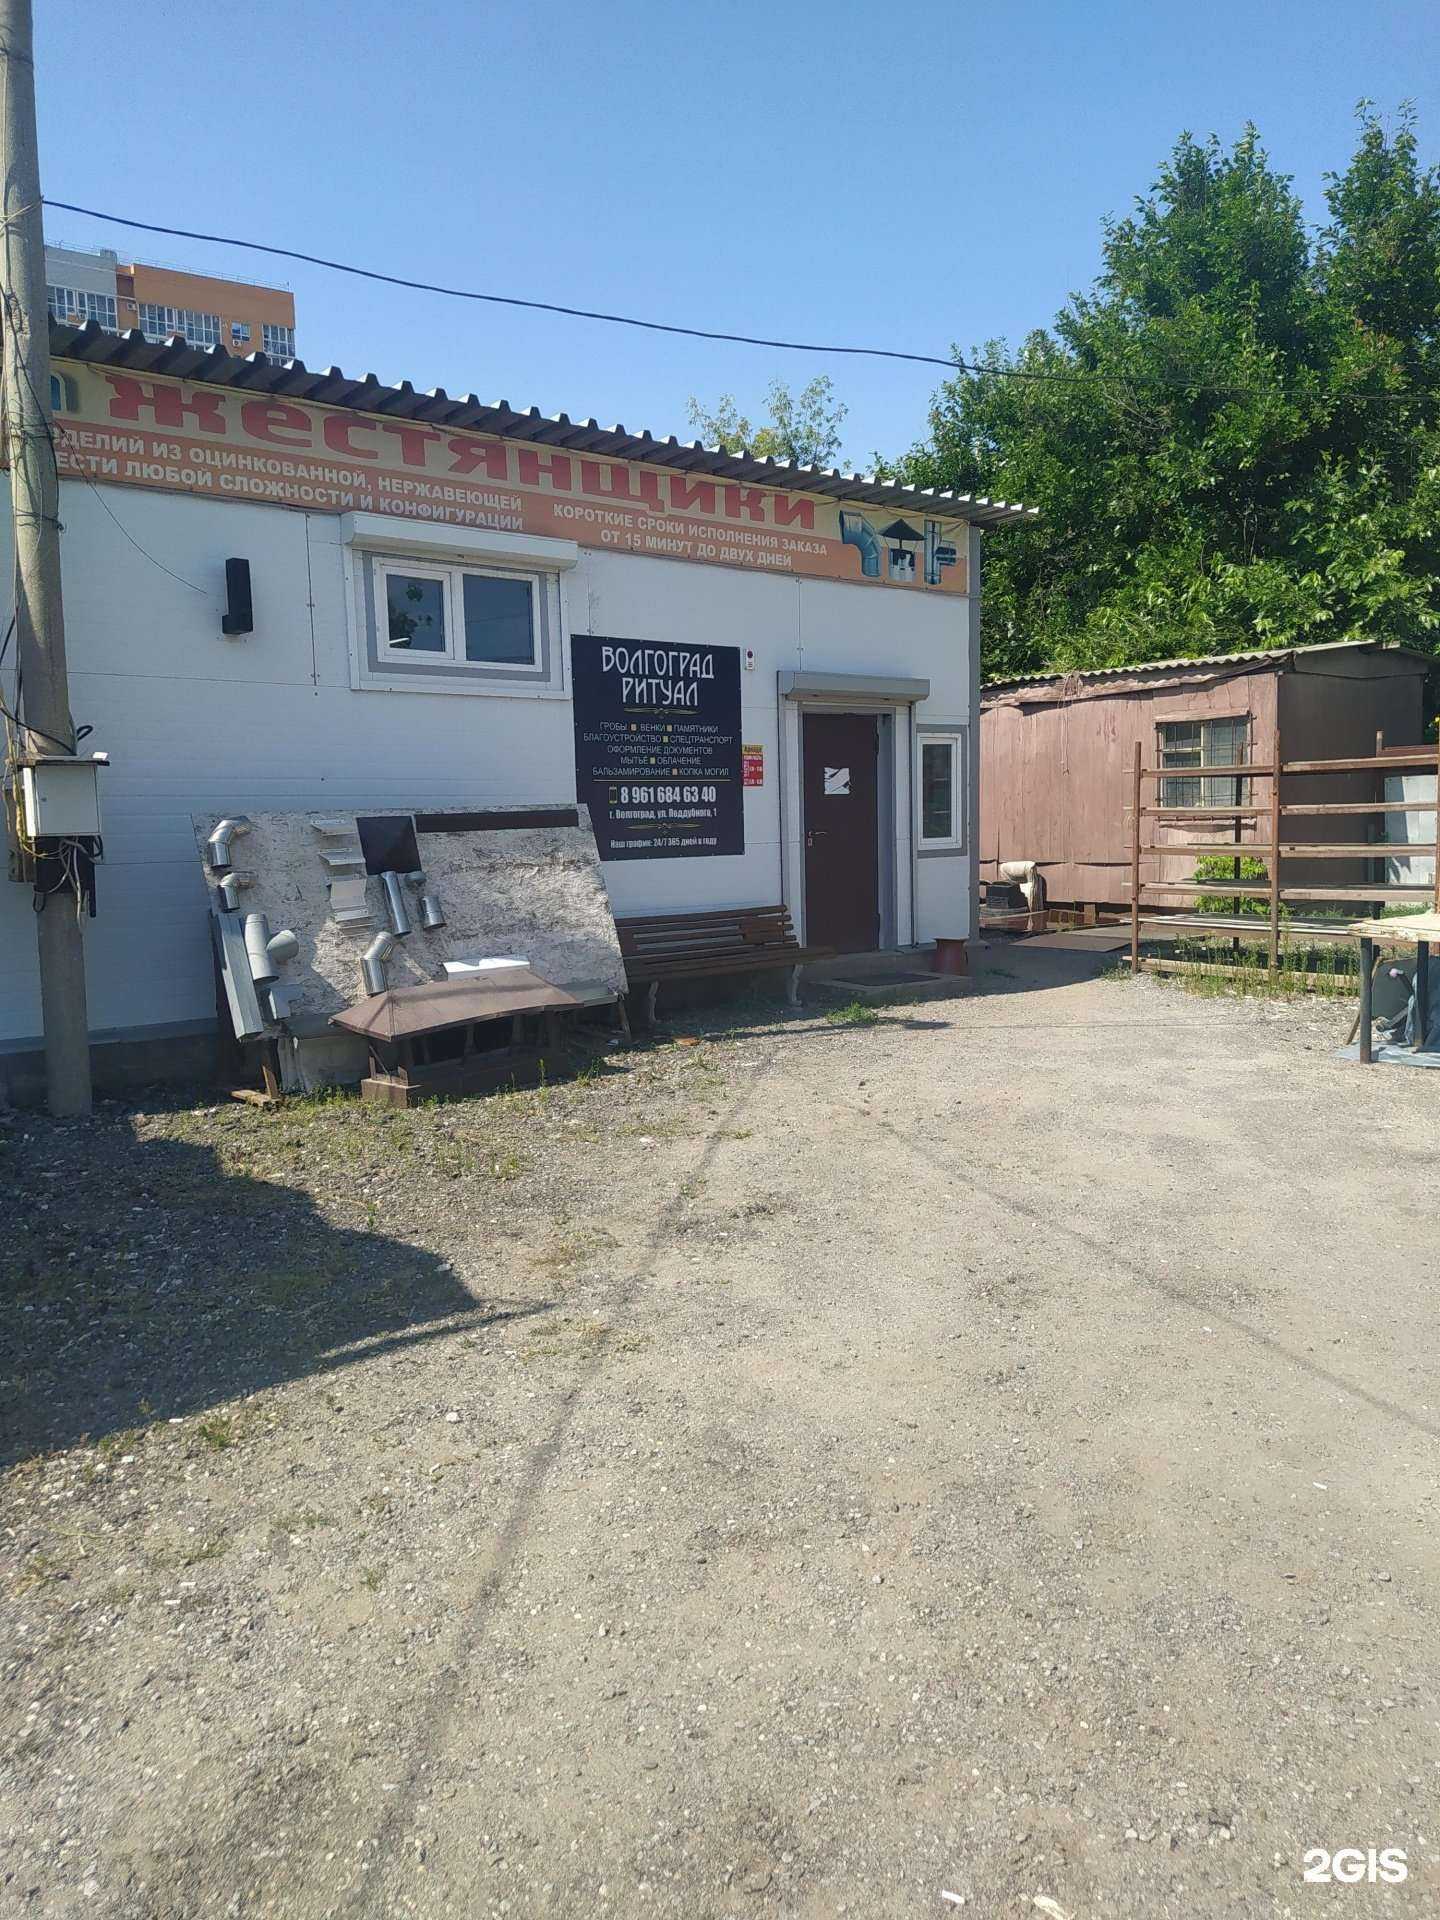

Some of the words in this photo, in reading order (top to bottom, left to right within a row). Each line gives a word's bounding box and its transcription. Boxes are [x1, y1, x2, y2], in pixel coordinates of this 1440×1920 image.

[53, 427, 145, 455] ДЕЛИЙ
[152, 441, 182, 460] ИЗ
[190, 447, 371, 491] ОЦИНКОВАННОЙ,
[378, 477, 522, 512] НЕРЖАВЕЮЩЕЙ
[55, 452, 118, 474] ЕСТИ
[125, 461, 213, 487] ЛЮБОЙ
[220, 474, 353, 507] СЛОЖНОСТИ
[361, 497, 373, 510] И
[379, 498, 523, 531] КОНФИГУРАЦИИ
[553, 503, 633, 528] КОРОТКИЕ
[637, 516, 684, 534] СРОКИ
[689, 524, 778, 548] ИСПОЛНЕНИЯ
[782, 538, 828, 555] ЗАКАЗА
[601, 530, 620, 544] ОТ
[625, 533, 641, 547] 15
[645, 535, 693, 554] МИНУТ
[696, 543, 716, 558] ДО
[719, 545, 754, 564] ДВУХ
[757, 551, 792, 567] ДНЕЙ
[601, 646, 715, 679] ВОЛГОГРАД
[622, 677, 698, 706] РИТУАЛ
[600, 722, 627, 731] ГРОБЫ
[640, 723, 665, 732] ВЕНКИ
[674, 725, 718, 734] ПАМЯТНИКИ
[584, 733, 661, 743] БЛАГОУСТРОЙСТВО
[669, 736, 733, 745] СПЕЦТРАНСПОРТ
[607, 745, 661, 754] ОФОРМЛЕНИЕ
[663, 746, 713, 755] ДОКУМЕНТОВ
[657, 757, 701, 765] ОБЛАЧЕНИЕ
[593, 767, 670, 776] БАЛЬЗАМИРОВАНИЕ
[678, 768, 703, 776] КОПКА
[704, 768, 729, 776] МОГИЛ
[620, 787, 628, 803] 8
[632, 787, 655, 803] 961
[657, 786, 680, 803] 684
[683, 786, 699, 802] 63
[701, 786, 717, 802] 40
[610, 839, 625, 848] Наш
[653, 838, 667, 847] 24/7
[668, 838, 680, 847] 365
[681, 836, 697, 847] дней
